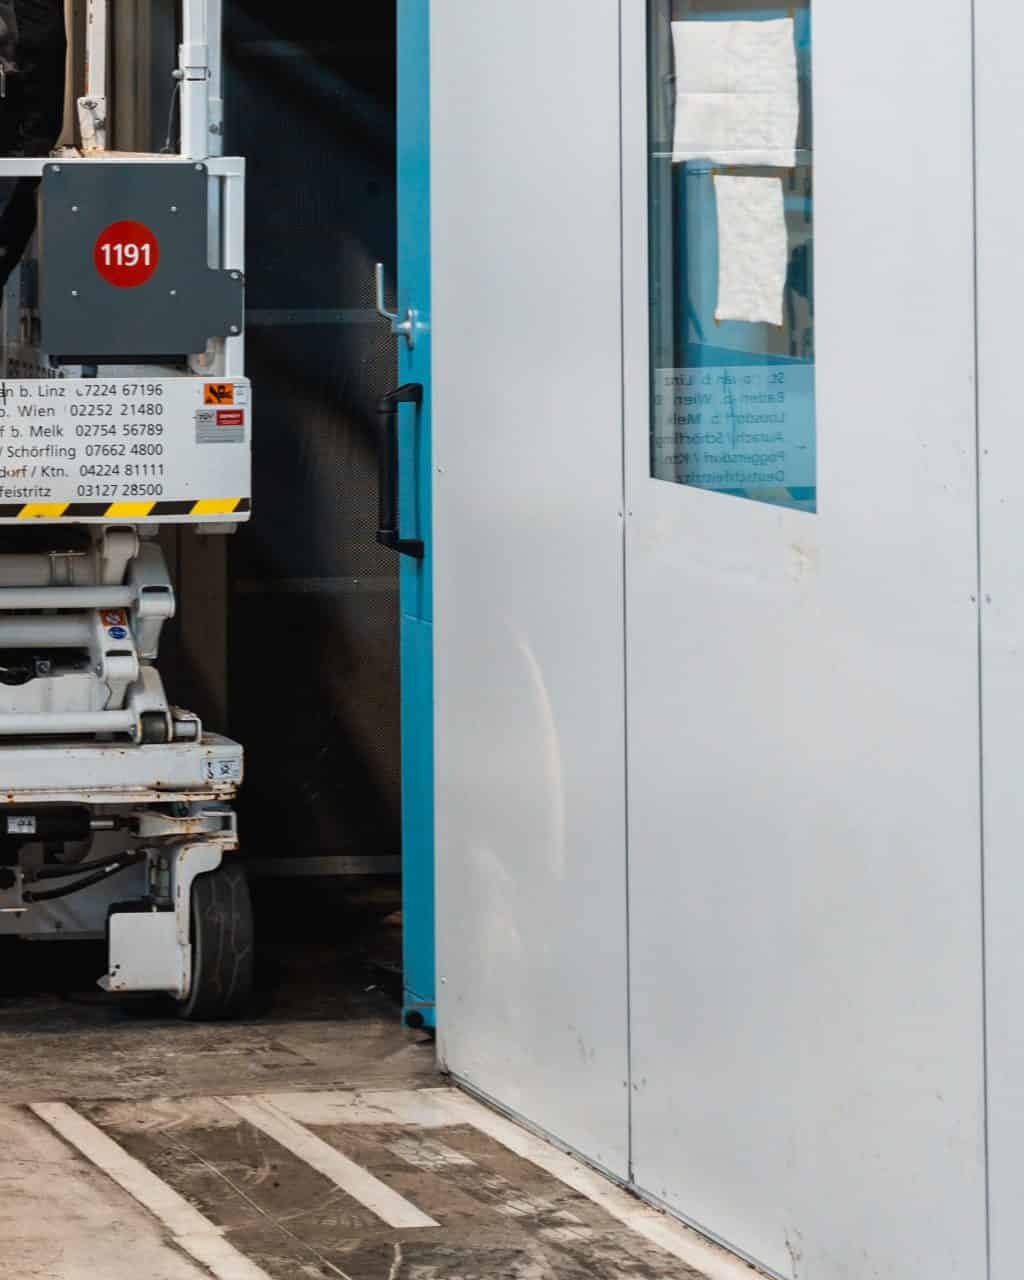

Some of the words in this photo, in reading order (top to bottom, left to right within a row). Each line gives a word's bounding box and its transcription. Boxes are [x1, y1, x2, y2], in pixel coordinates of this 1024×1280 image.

[100, 243, 151, 266] 1191
[19, 384, 32, 398] b.
[38, 383, 65, 398] Linz
[122, 383, 163, 396] 67196
[18, 404, 56, 417] Wien
[70, 404, 113, 417] 02252
[120, 403, 163, 416] 21480
[11, 424, 23, 438] b.
[30, 423, 64, 437] Melk
[75, 424, 117, 437] 02754
[122, 423, 163, 436] 56789
[7, 444, 76, 460] Schörfling
[85, 444, 126, 457] 07662
[130, 443, 163, 456] 4800
[41, 464, 69, 478] Ktn.
[79, 464, 120, 477] 04224
[124, 464, 164, 477] 81111
[77, 484, 118, 497] 03127
[122, 484, 163, 496] 28500
